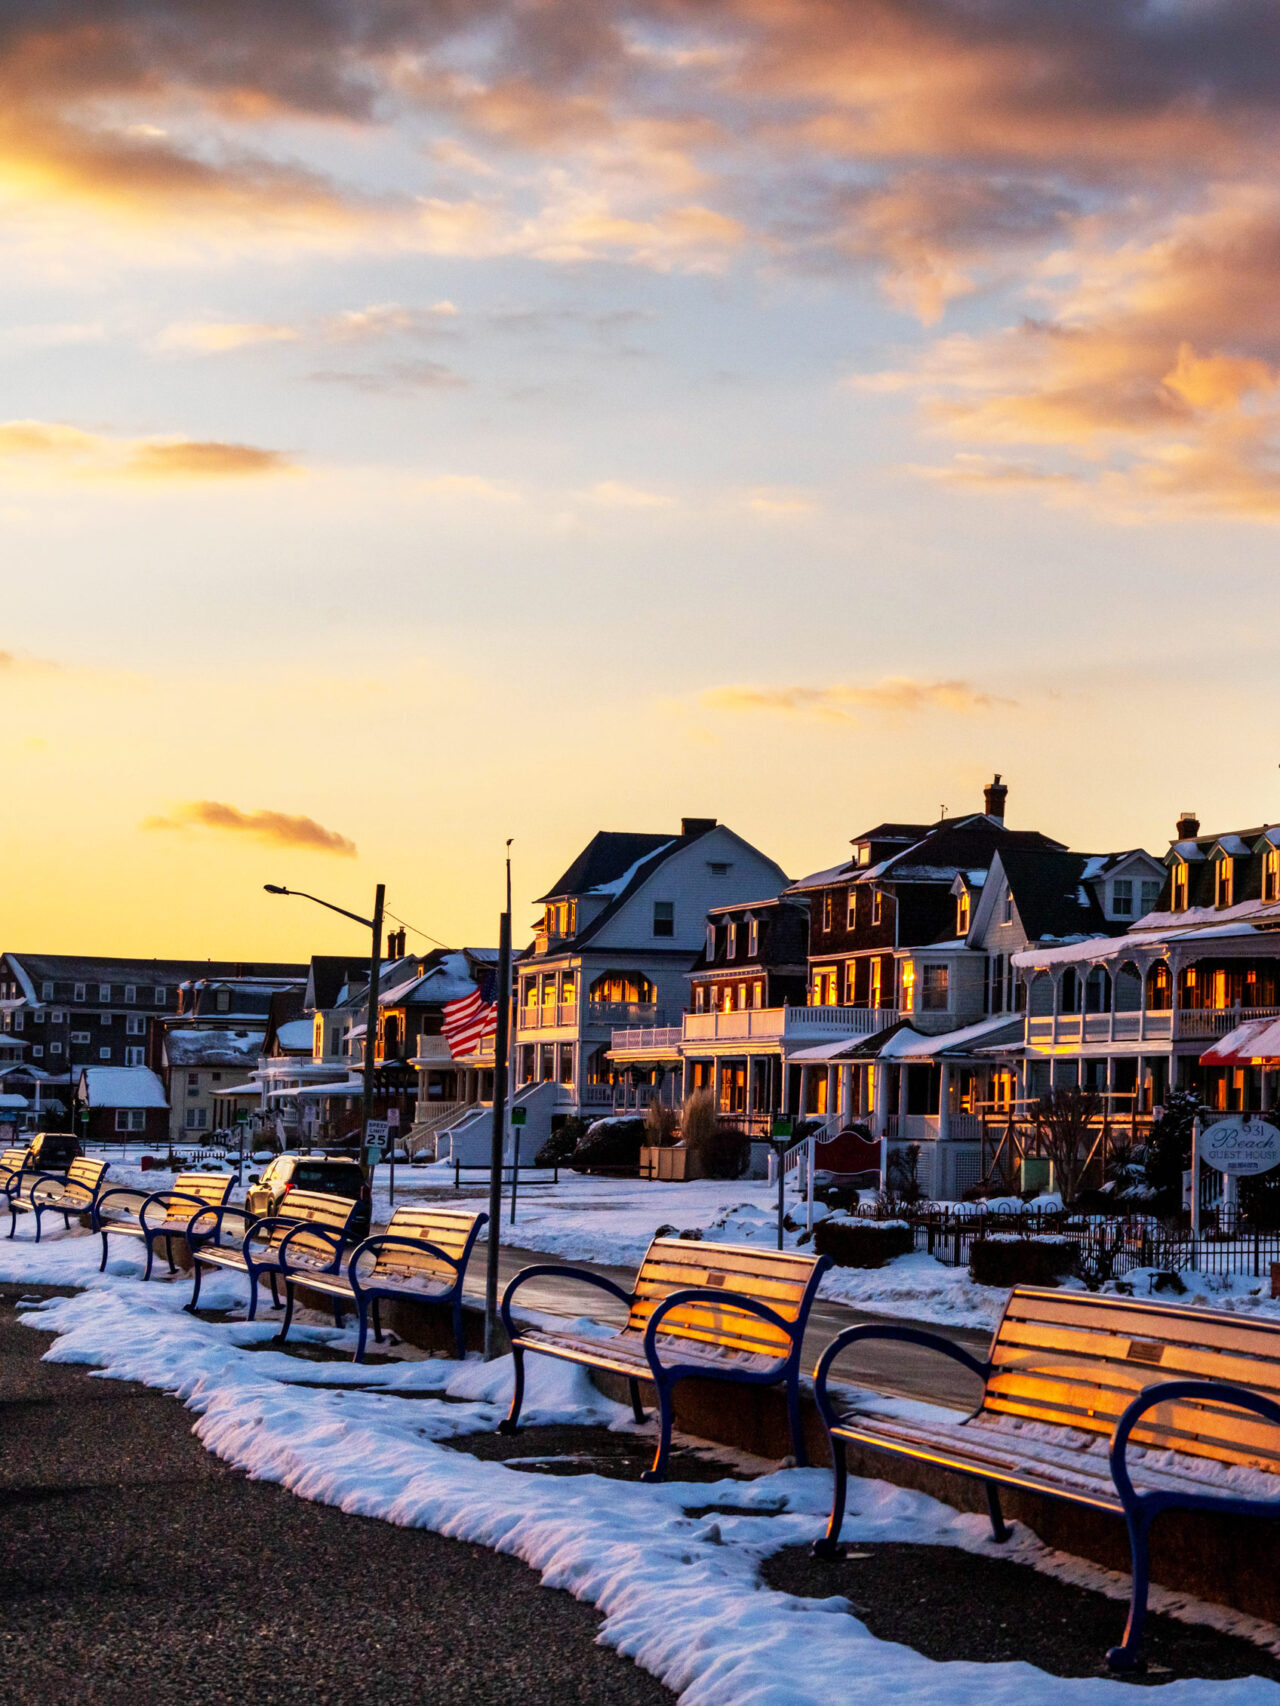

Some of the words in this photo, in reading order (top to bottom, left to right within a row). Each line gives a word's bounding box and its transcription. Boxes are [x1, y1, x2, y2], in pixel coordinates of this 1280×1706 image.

[1242, 1125, 1264, 1136] 931
[367, 1134, 386, 1145] 25
[1211, 1128, 1275, 1148] Beach
[1209, 1151, 1240, 1159] GUEST
[1246, 1151, 1276, 1159] HOUSE
